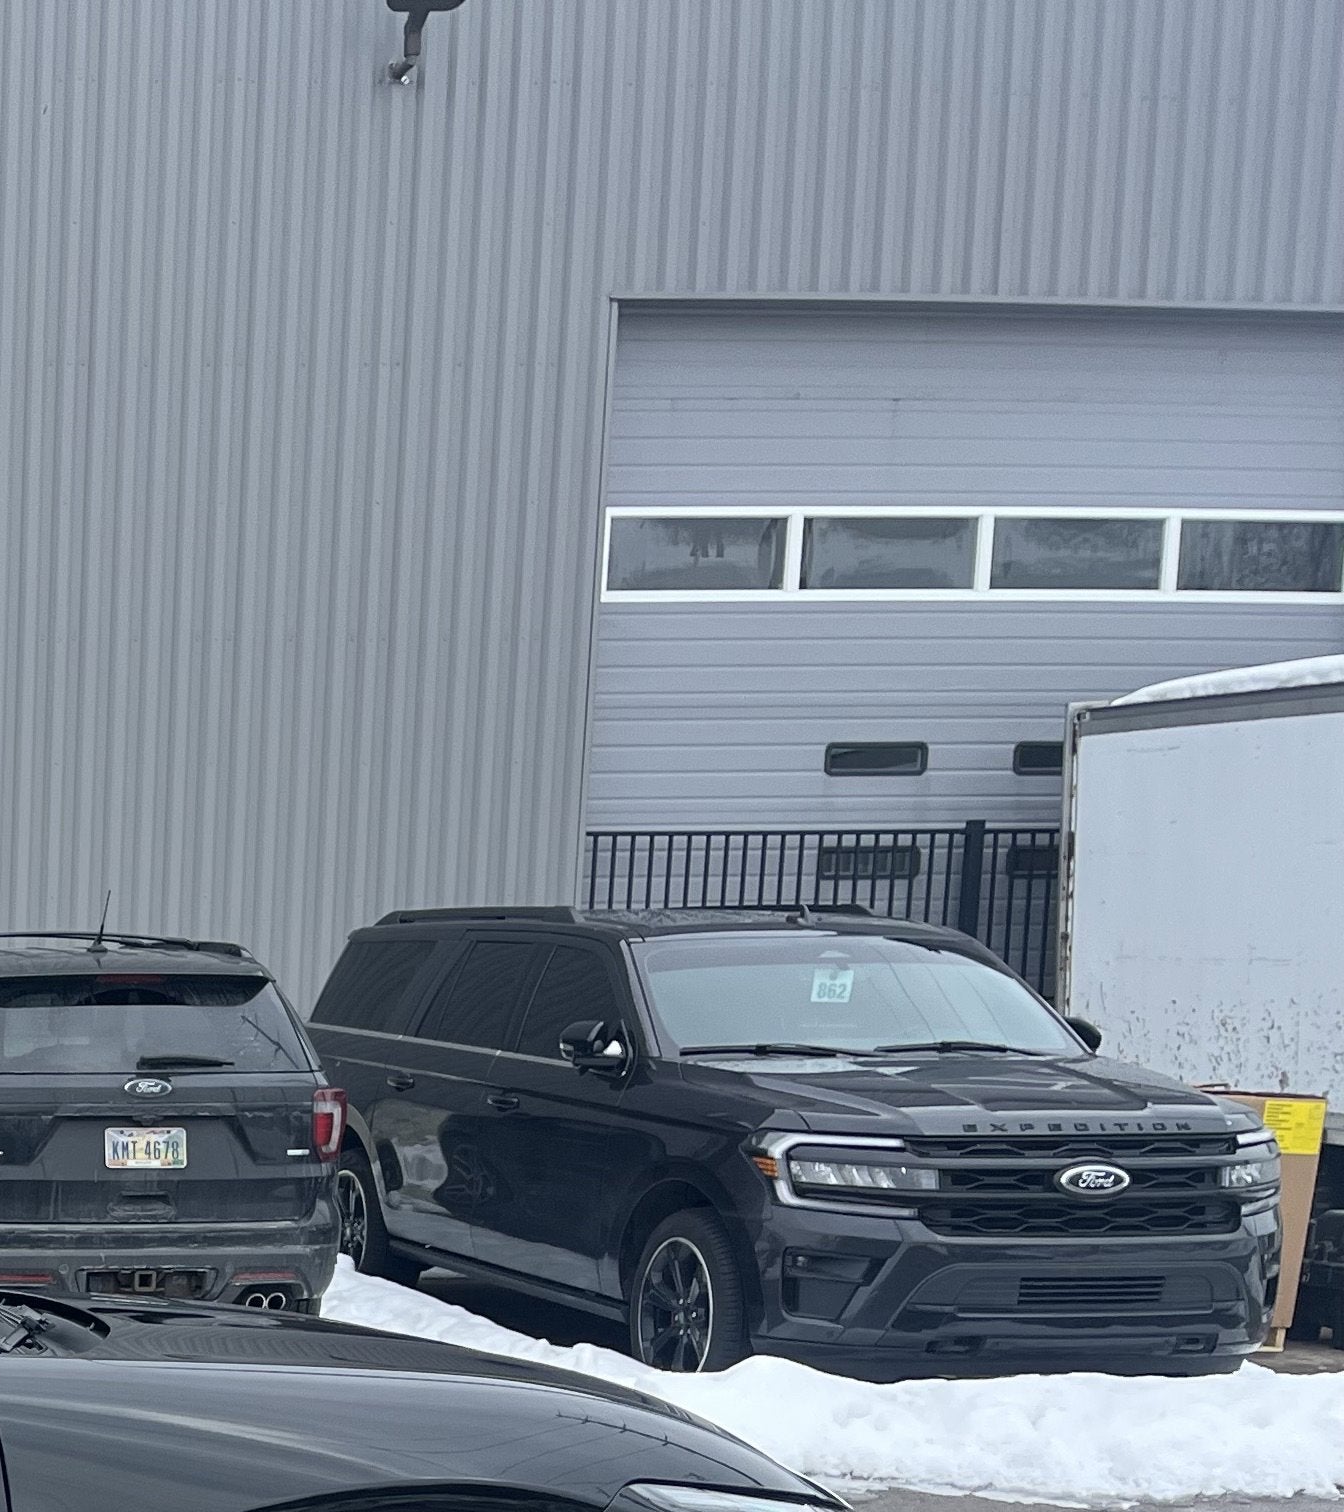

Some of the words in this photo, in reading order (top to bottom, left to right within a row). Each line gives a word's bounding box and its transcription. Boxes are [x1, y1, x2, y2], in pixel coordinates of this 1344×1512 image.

[816, 982, 847, 999] 862
[962, 1122, 1192, 1132] EXPEDITION
[112, 1140, 139, 1160] KMT
[144, 1140, 179, 1160] 4678
